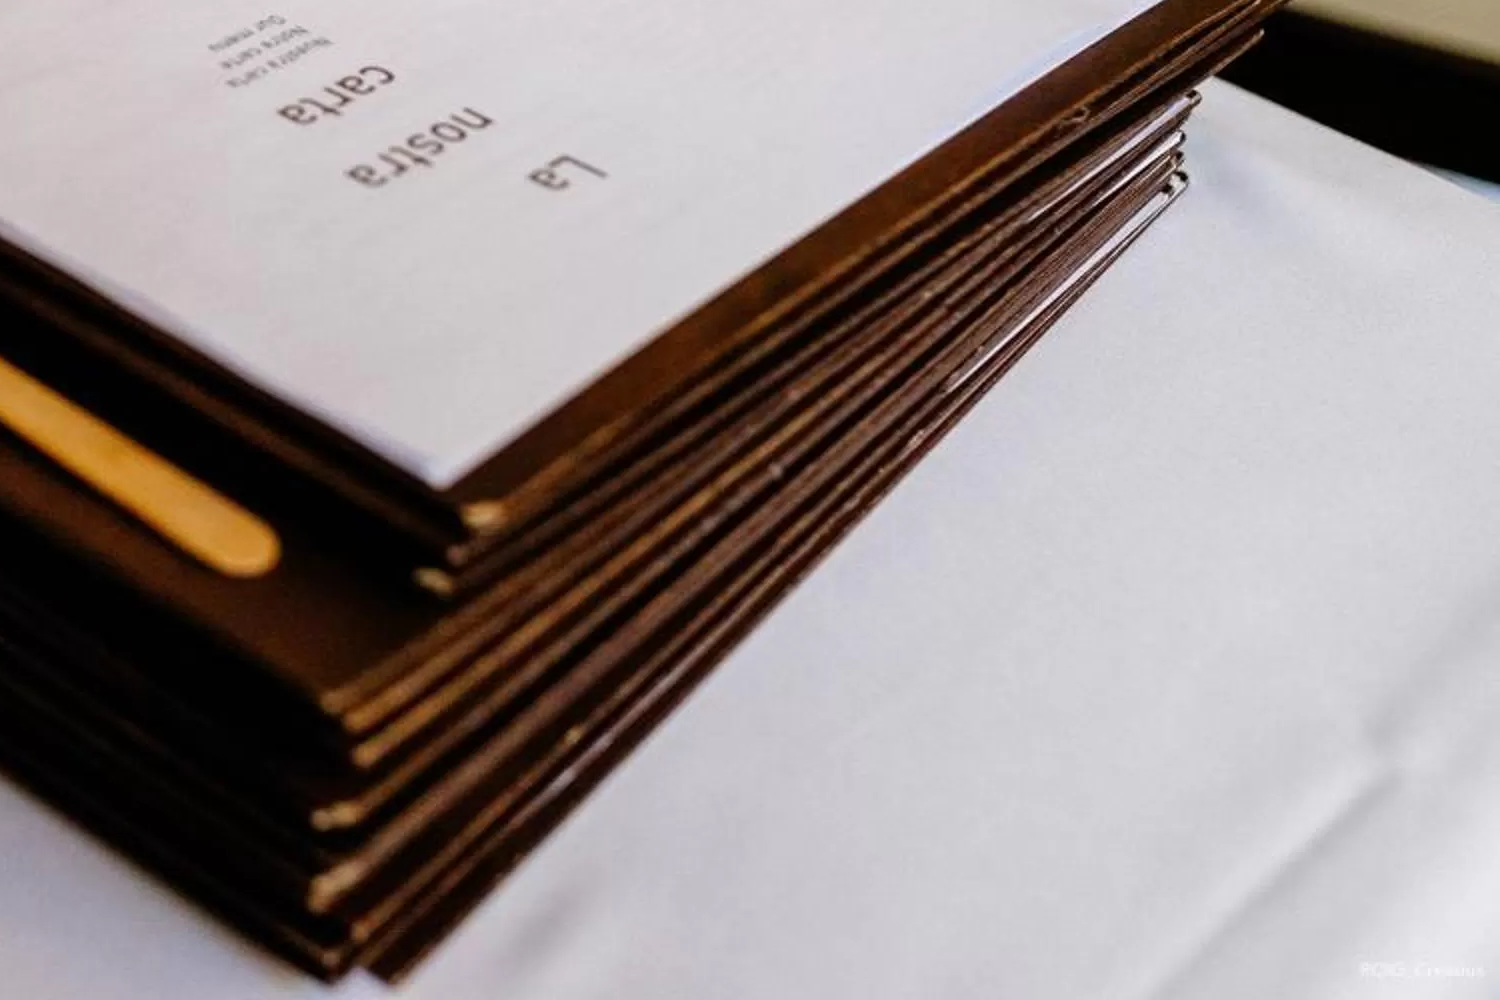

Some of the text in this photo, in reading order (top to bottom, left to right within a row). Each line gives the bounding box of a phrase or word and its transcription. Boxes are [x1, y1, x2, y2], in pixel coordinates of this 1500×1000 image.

[277, 64, 396, 126] carta
[344, 106, 496, 190] nostra
[527, 152, 609, 192] La
